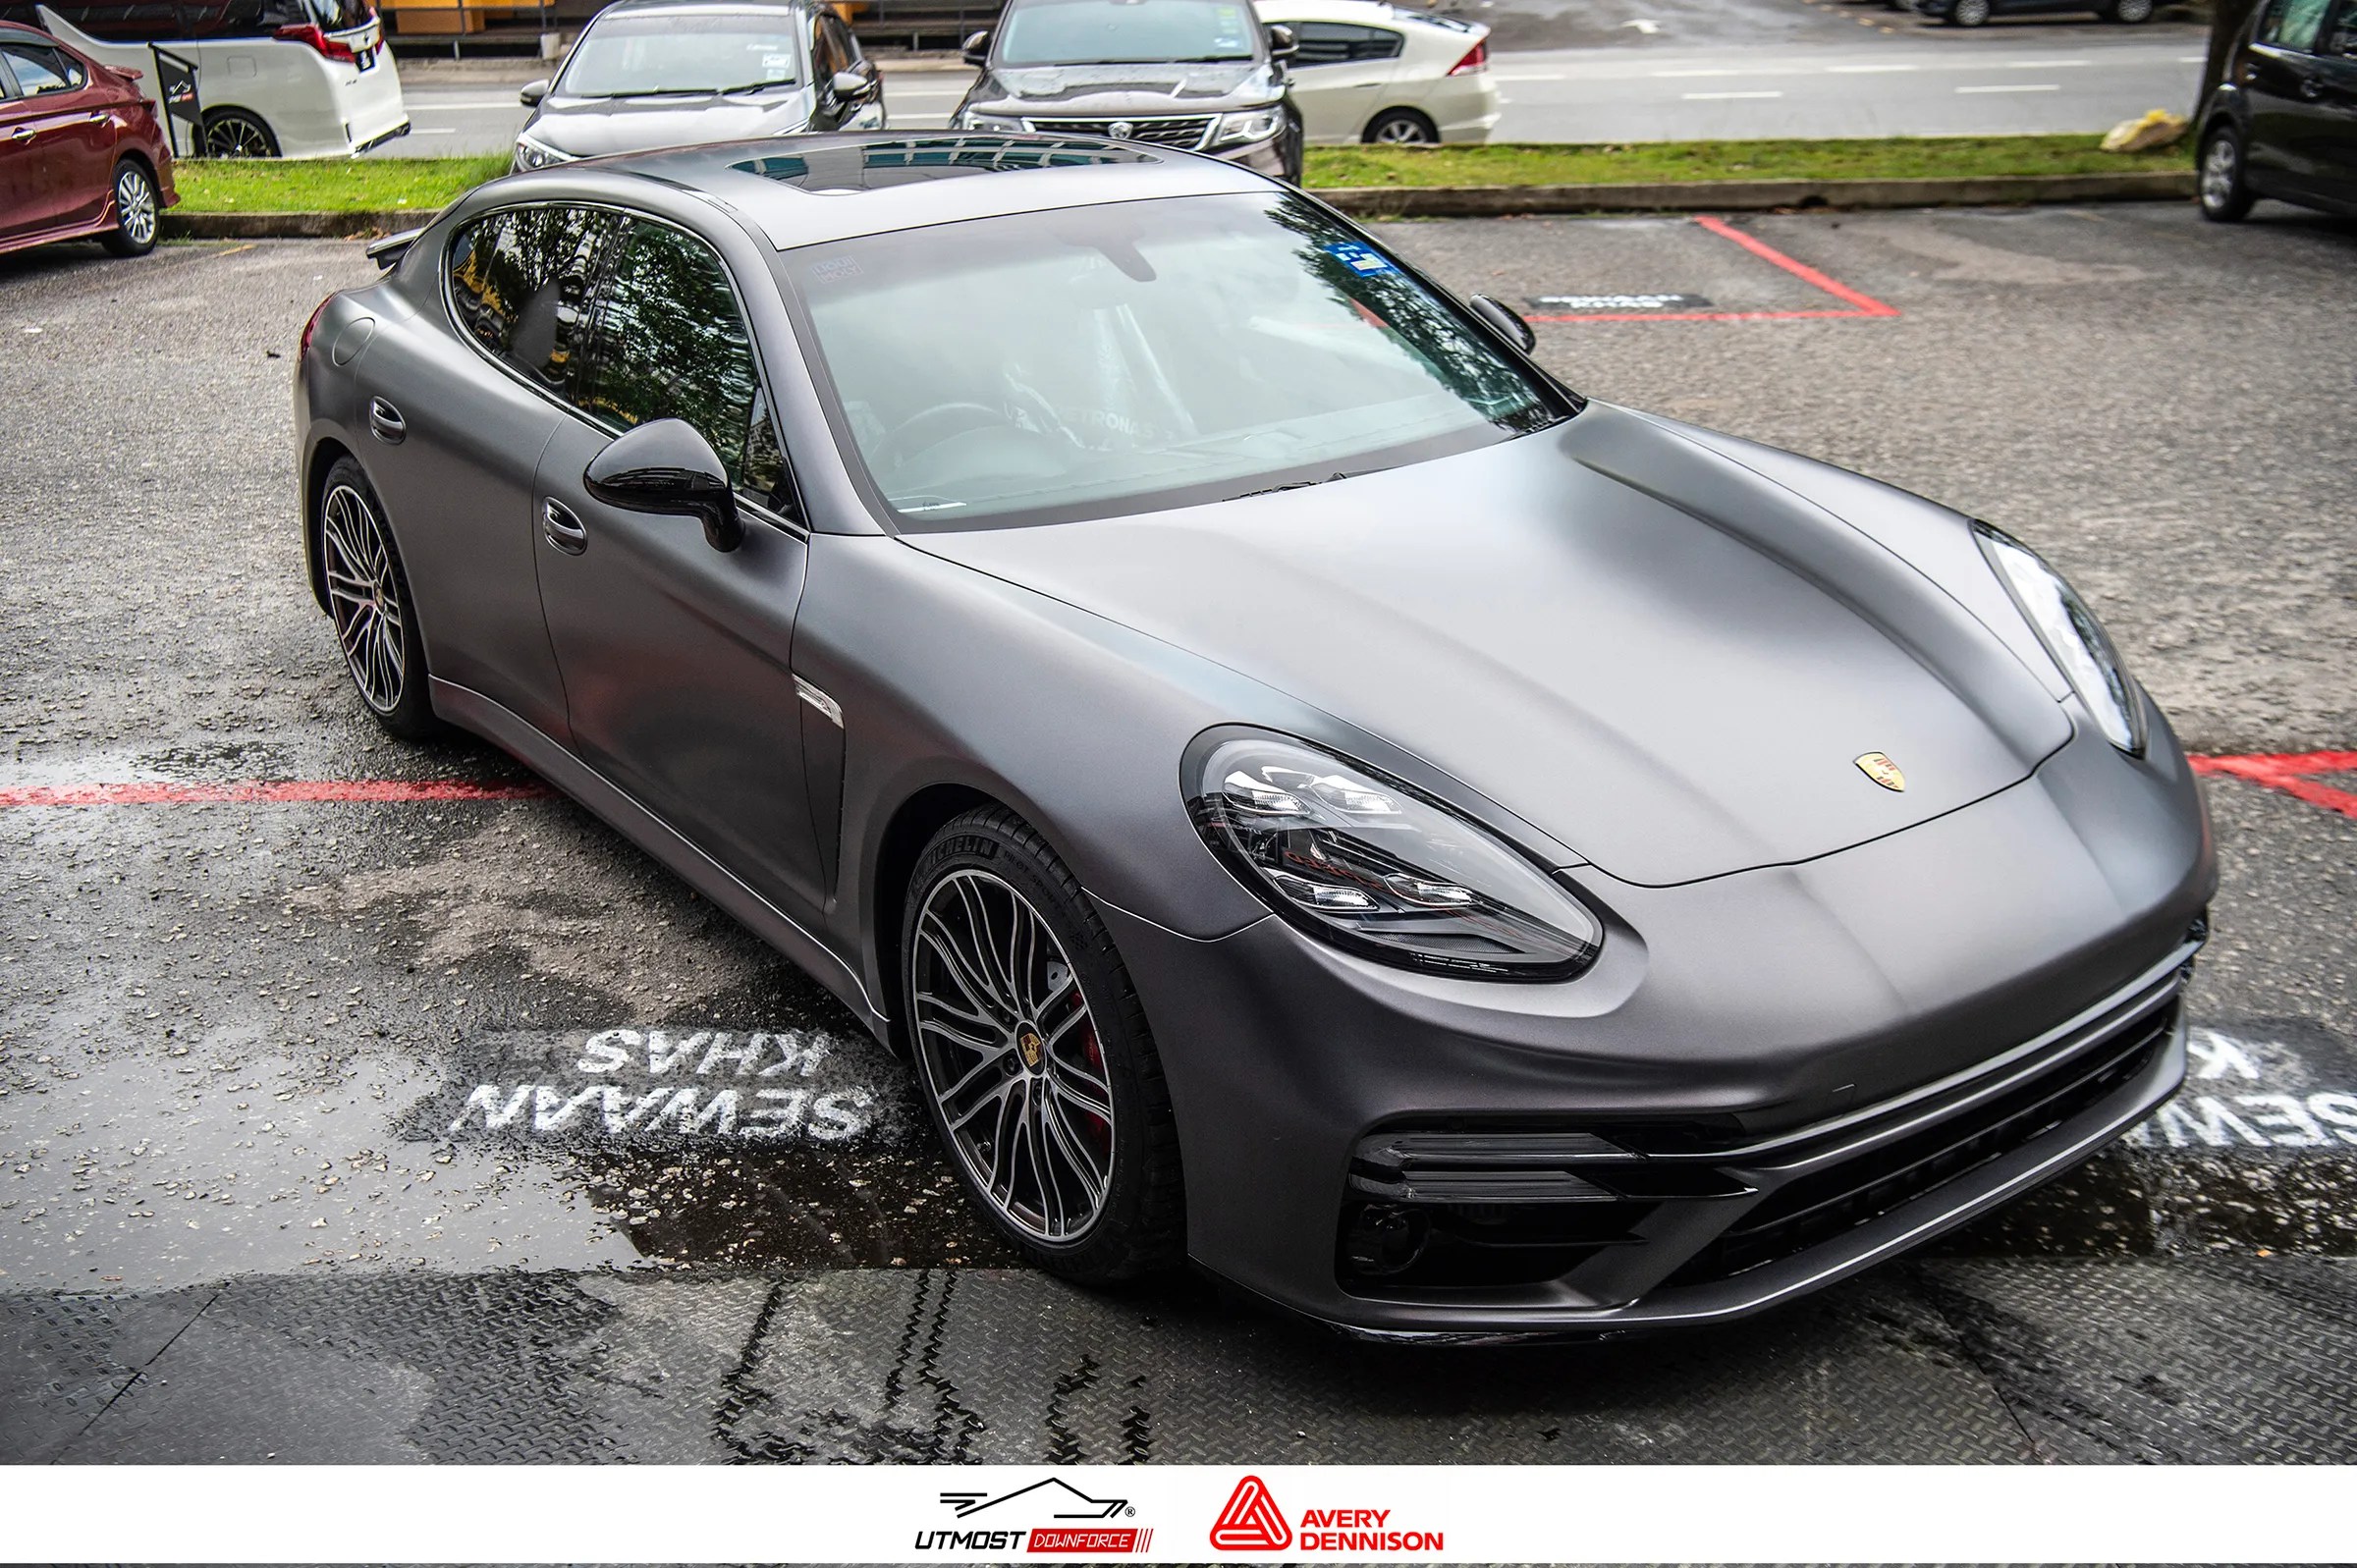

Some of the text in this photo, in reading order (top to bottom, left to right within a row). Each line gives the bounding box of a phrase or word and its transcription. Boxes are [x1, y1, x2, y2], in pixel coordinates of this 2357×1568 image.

[1059, 408, 1154, 439] ETRONAS
[921, 837, 994, 872] MICHELIN
[576, 1028, 832, 1076] KHAS
